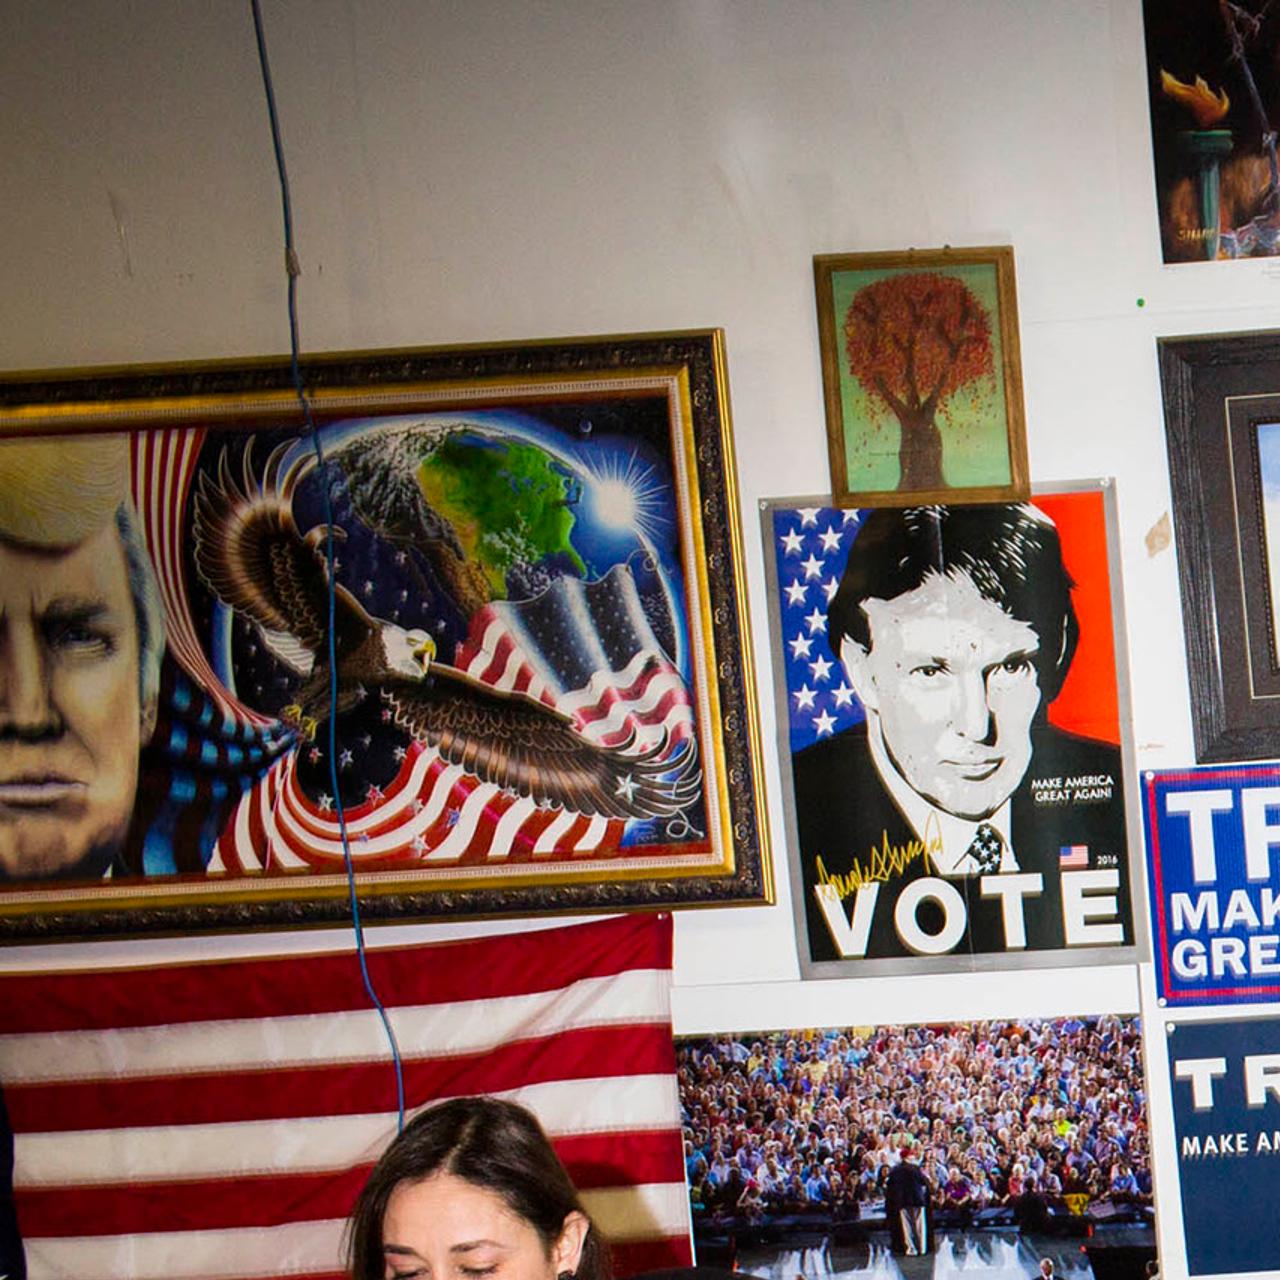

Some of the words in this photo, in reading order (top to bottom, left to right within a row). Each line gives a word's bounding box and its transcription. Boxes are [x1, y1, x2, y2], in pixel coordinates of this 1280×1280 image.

[1031, 777, 1062, 790] MAKE
[1064, 775, 1114, 788] AMERICA
[1035, 789, 1071, 802] GREAT
[1073, 787, 1112, 800] AGAIN!
[1097, 855, 1119, 865] 2016
[814, 868, 1125, 959] VOTE
[1182, 1133, 1250, 1157] MAKE
